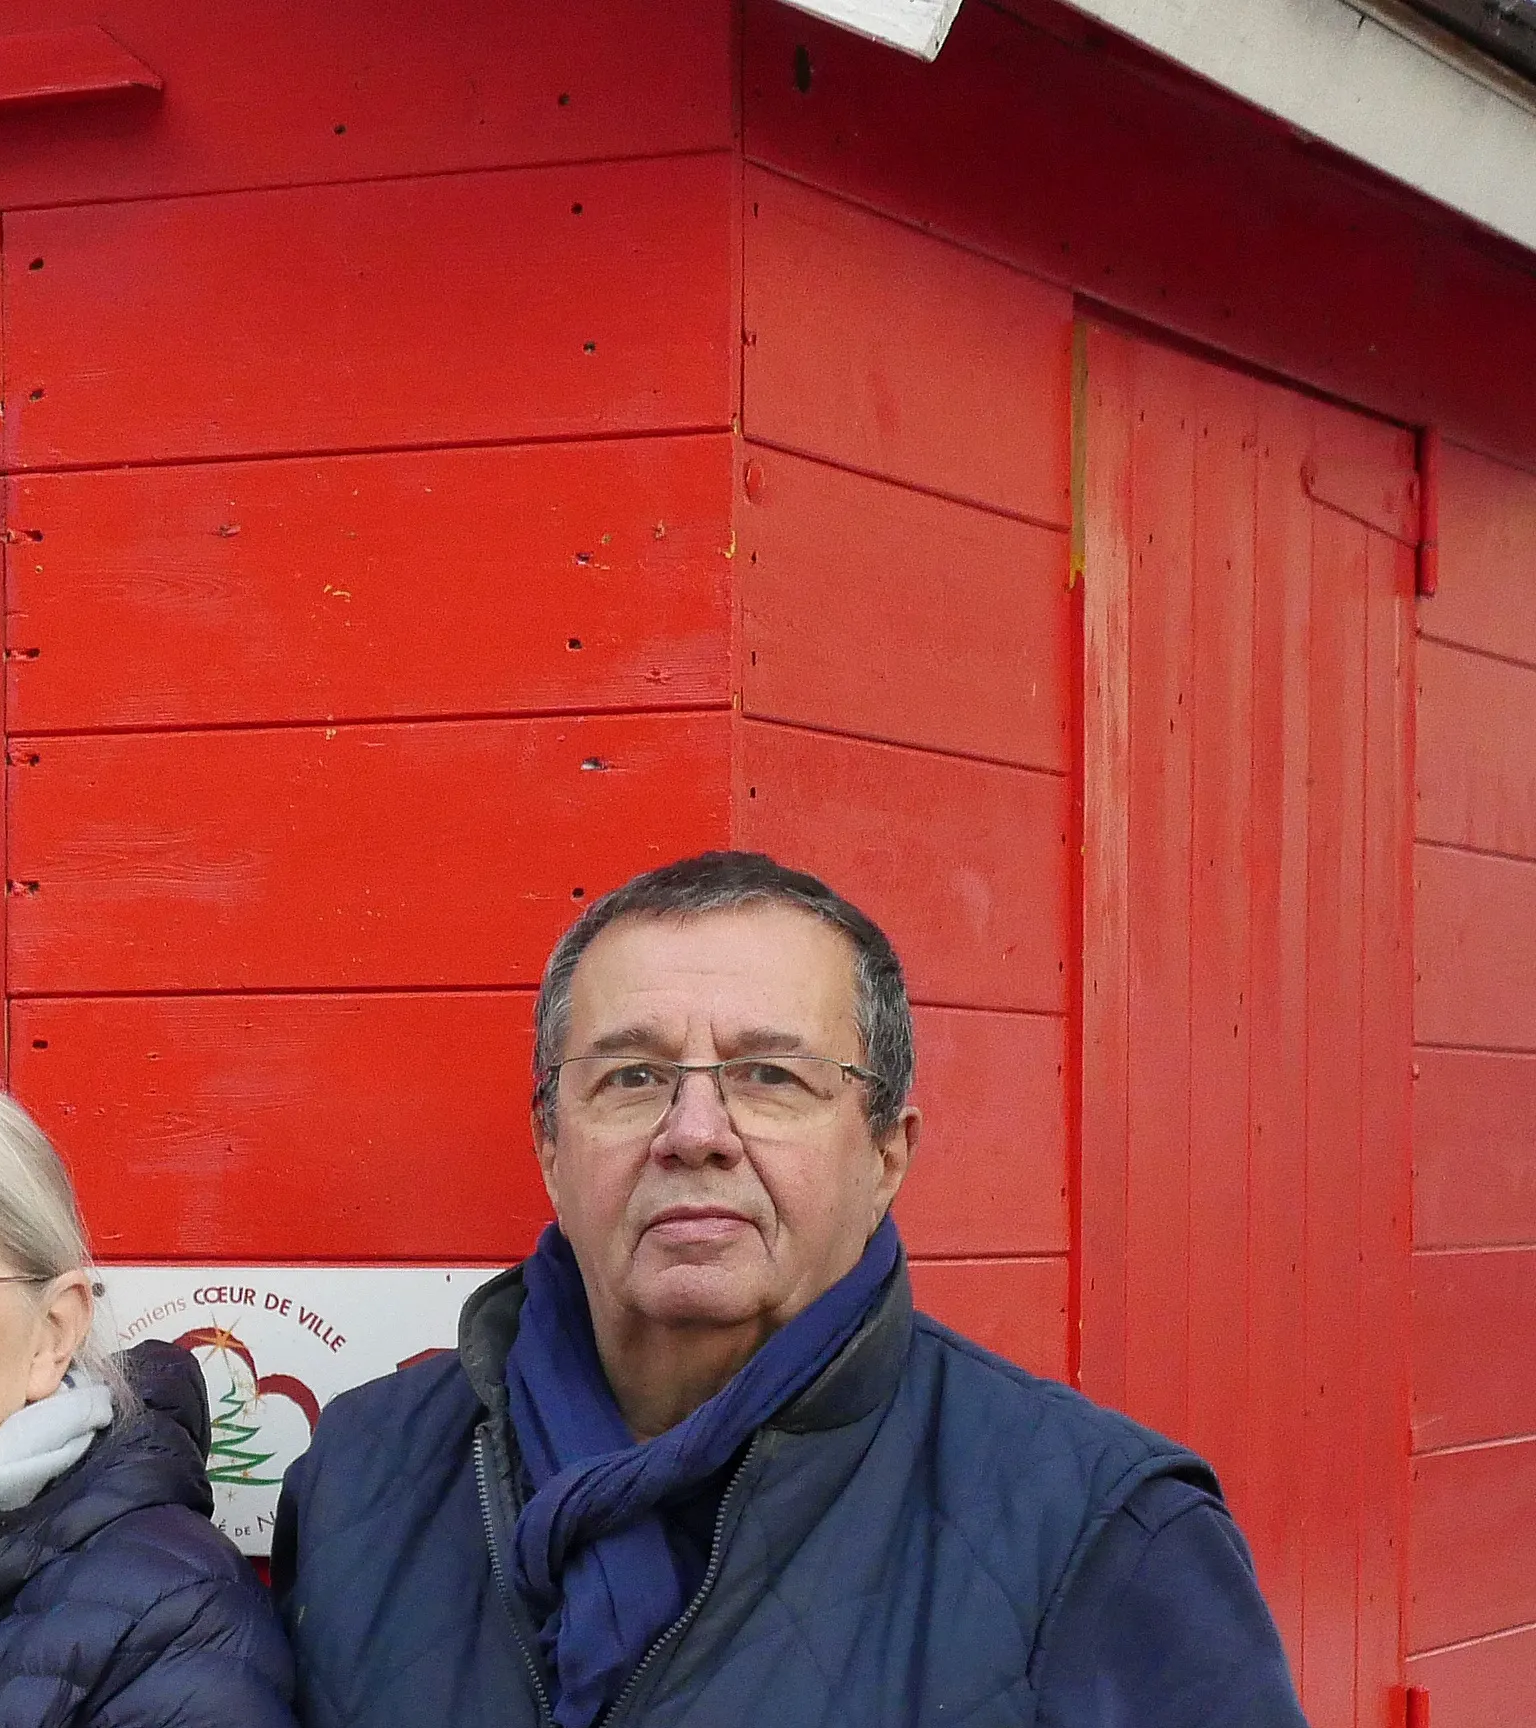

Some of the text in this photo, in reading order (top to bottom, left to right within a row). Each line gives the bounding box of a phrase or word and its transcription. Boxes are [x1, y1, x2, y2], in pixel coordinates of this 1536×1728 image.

[193, 1286, 257, 1307] CŒUR
[264, 1292, 293, 1317] DE
[298, 1306, 347, 1354] VILLE
[234, 1526, 251, 1537] DE
